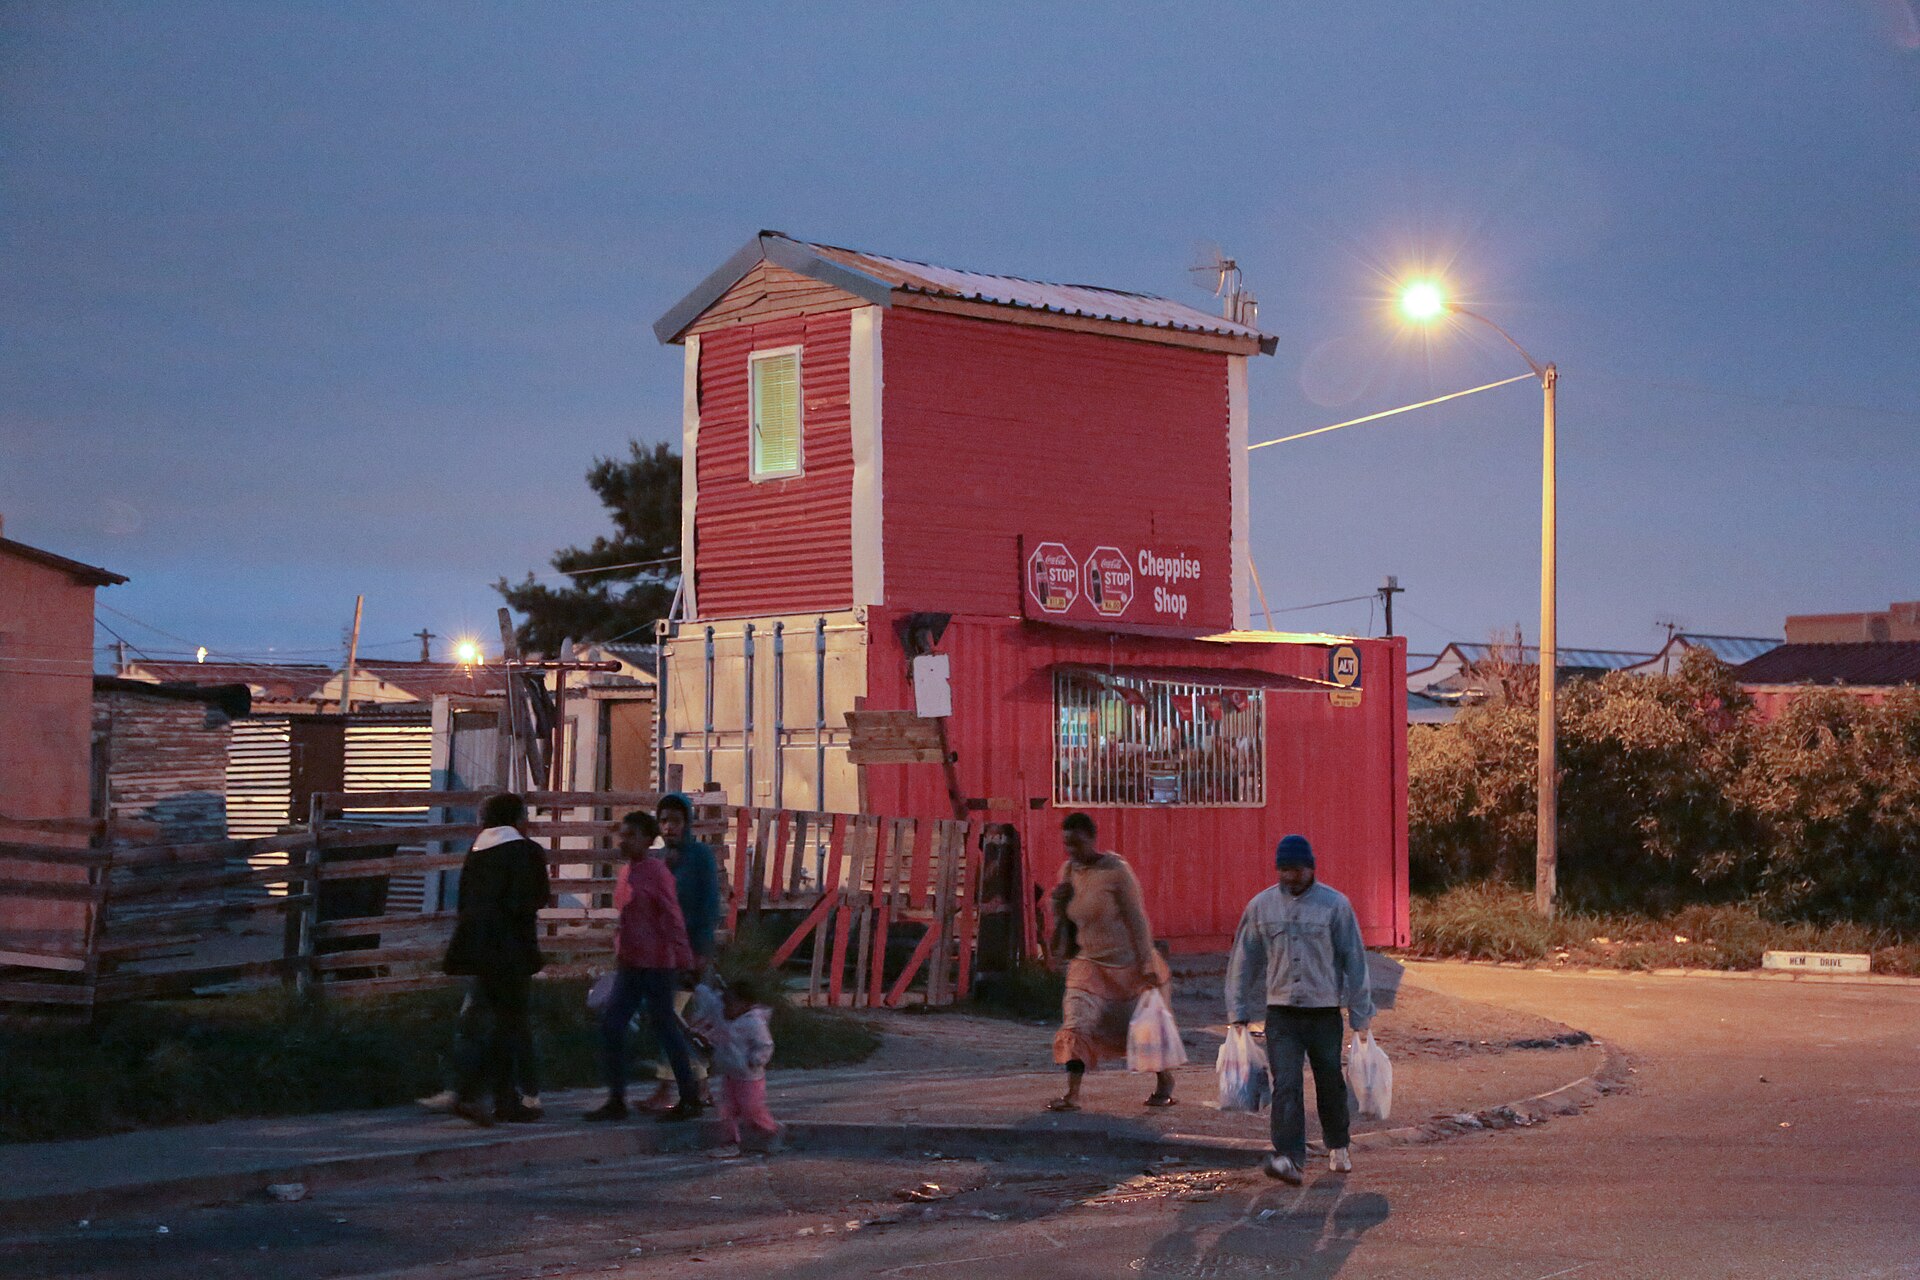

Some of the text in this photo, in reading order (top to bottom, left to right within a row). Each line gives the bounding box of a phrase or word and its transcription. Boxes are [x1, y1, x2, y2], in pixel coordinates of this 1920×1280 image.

[1138, 549, 1200, 584] Cheppise
[1049, 568, 1075, 583] STOP
[1105, 571, 1130, 586] STOP
[1154, 586, 1187, 620] Shop
[1820, 958, 1842, 967] DRIVE
